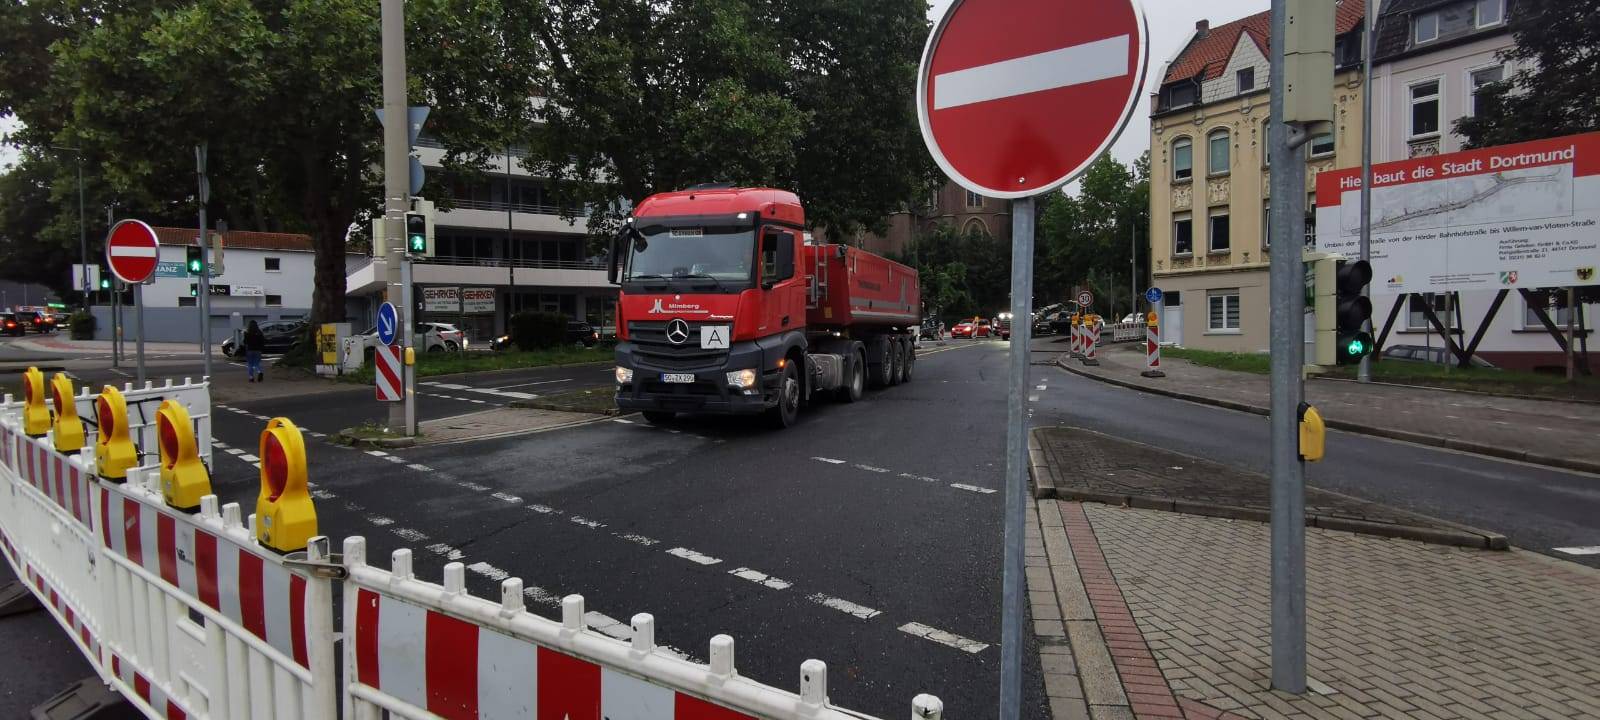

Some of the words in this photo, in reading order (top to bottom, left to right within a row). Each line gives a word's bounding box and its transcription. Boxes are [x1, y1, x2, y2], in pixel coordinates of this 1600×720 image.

[1340, 176, 1361, 189] Hie
[1373, 170, 1405, 185] baut
[1411, 165, 1434, 179] die
[1442, 158, 1482, 175] Stadt
[1490, 145, 1575, 169] Dortmund
[1439, 228, 1487, 239] Bahnhofstraße
[1489, 226, 1500, 234] bis
[465, 290, 495, 300] GEHRKEN
[1080, 295, 1090, 303] 30
[668, 303, 700, 311] Mimberg
[707, 329, 723, 346] A
